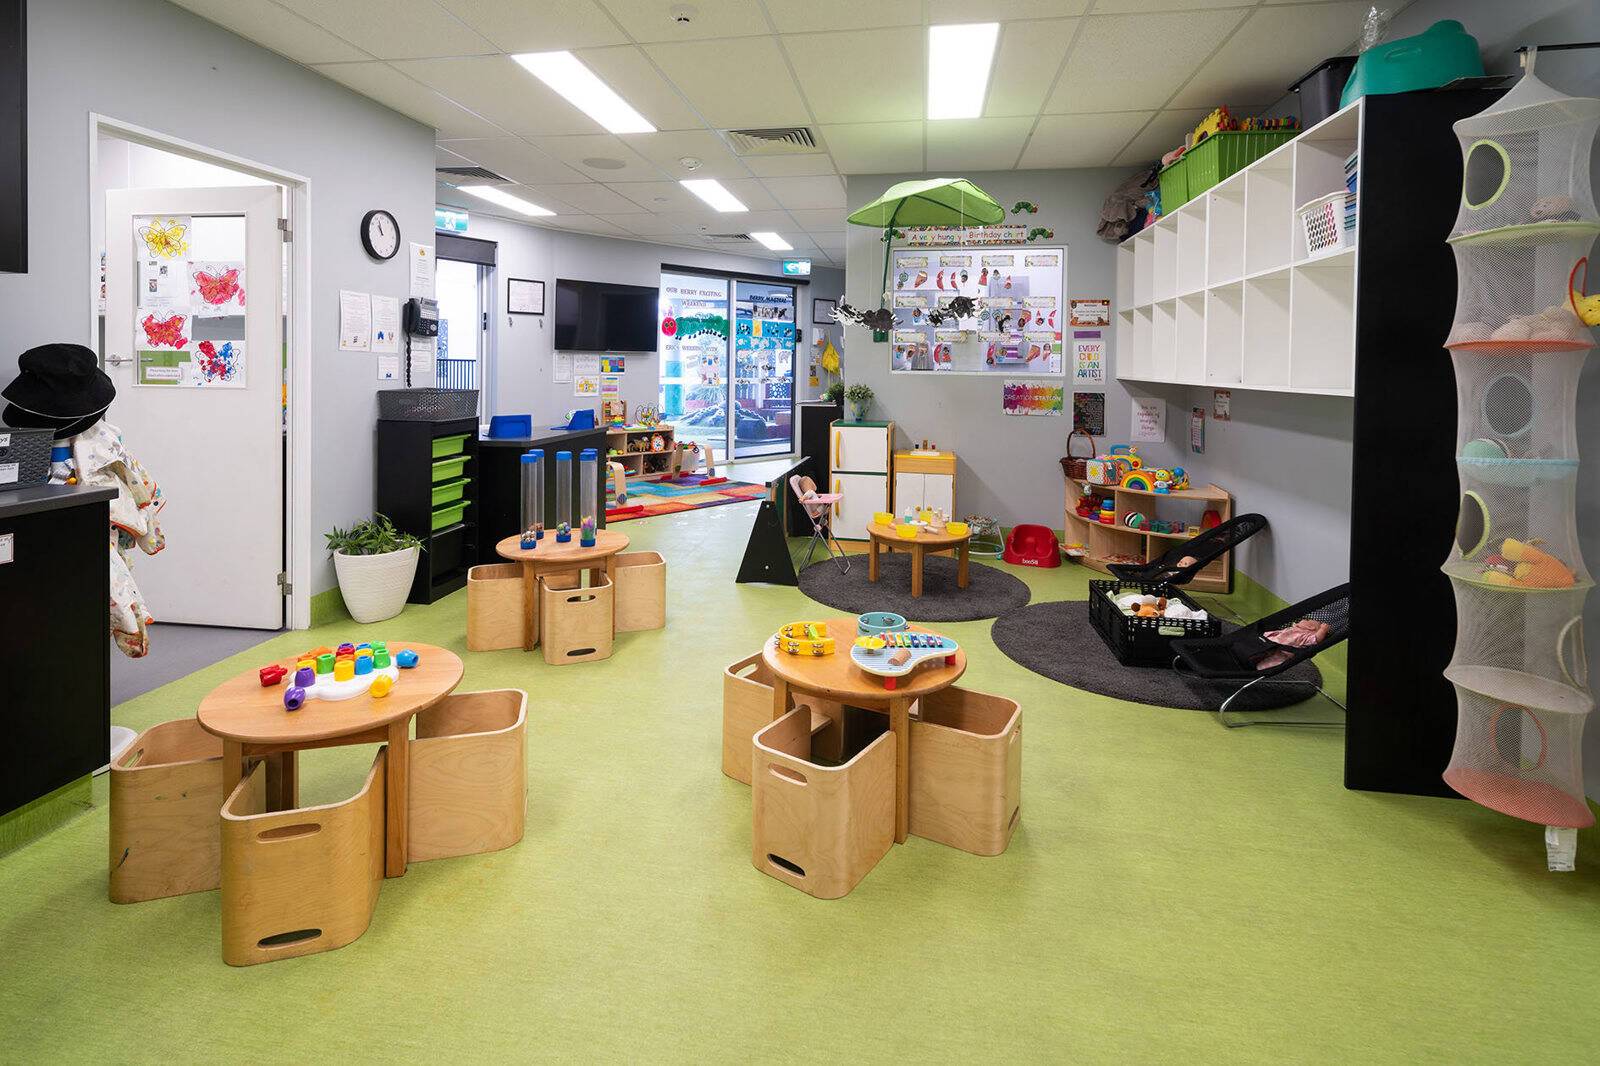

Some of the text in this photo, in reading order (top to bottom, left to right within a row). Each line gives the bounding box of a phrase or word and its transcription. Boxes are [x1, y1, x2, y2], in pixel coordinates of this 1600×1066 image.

[919, 234, 936, 242] vey
[937, 233, 962, 243] hungy
[968, 231, 1002, 240] Birthday
[1003, 230, 1025, 238] chrt
[1078, 344, 1101, 352] EVERY
[1087, 361, 1100, 369] AN
[1077, 369, 1102, 378] ARTIST
